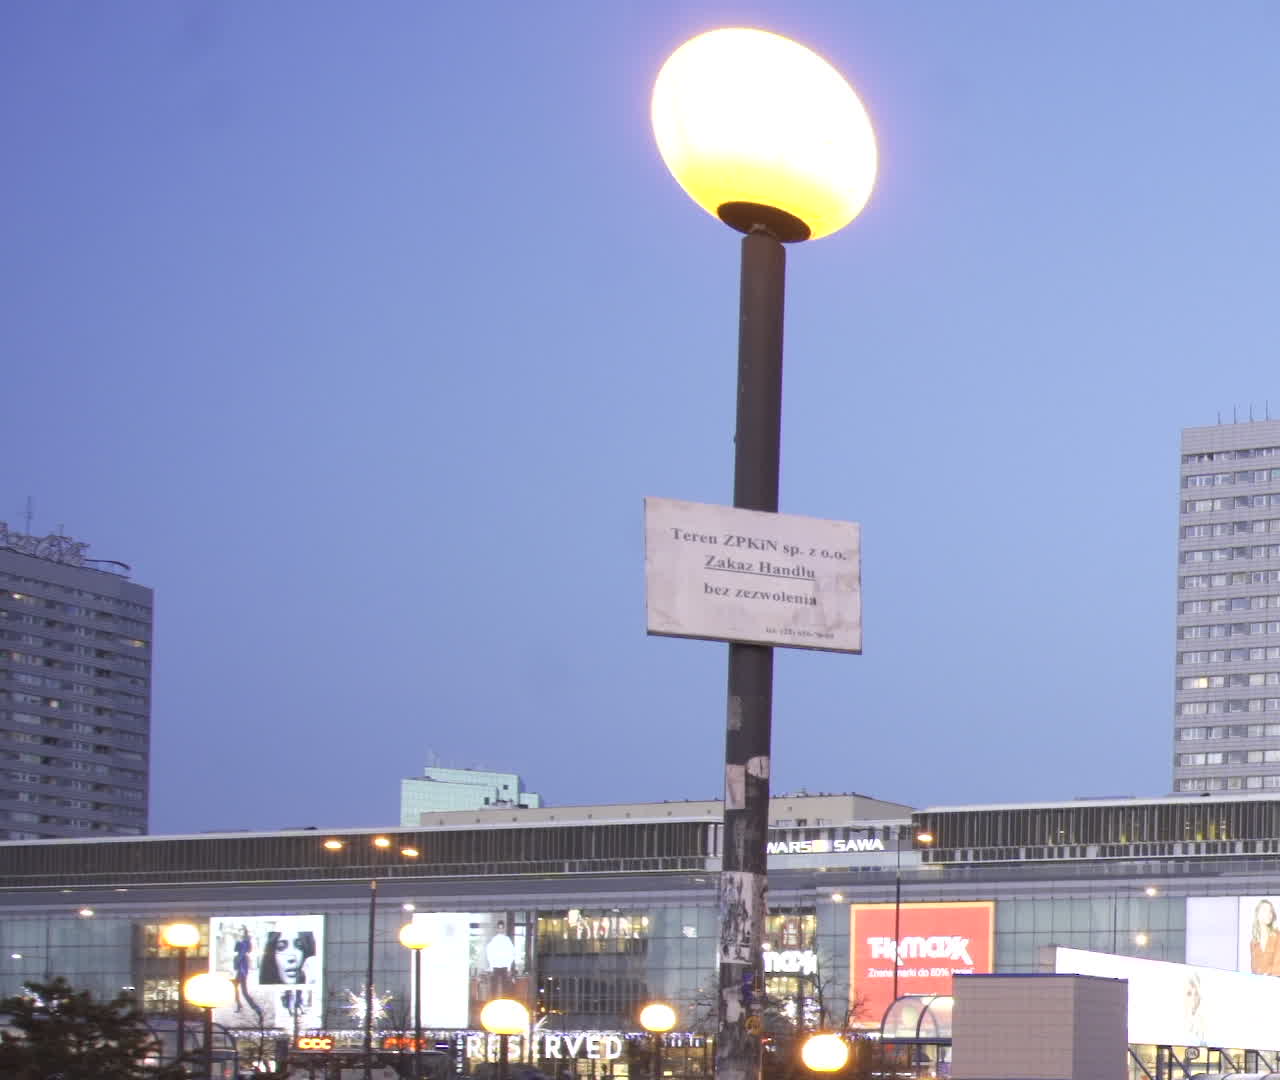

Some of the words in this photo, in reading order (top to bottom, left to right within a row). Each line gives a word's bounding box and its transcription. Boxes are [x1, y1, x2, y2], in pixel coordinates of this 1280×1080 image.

[670, 527, 717, 545] Teren
[723, 534, 777, 552] ZPKiN
[783, 543, 804, 558] sp.
[809, 548, 817, 557] z
[704, 554, 753, 573] Zakaz
[759, 561, 816, 579] Handlu
[704, 582, 729, 596] bez
[735, 587, 817, 607] zezwolenia
